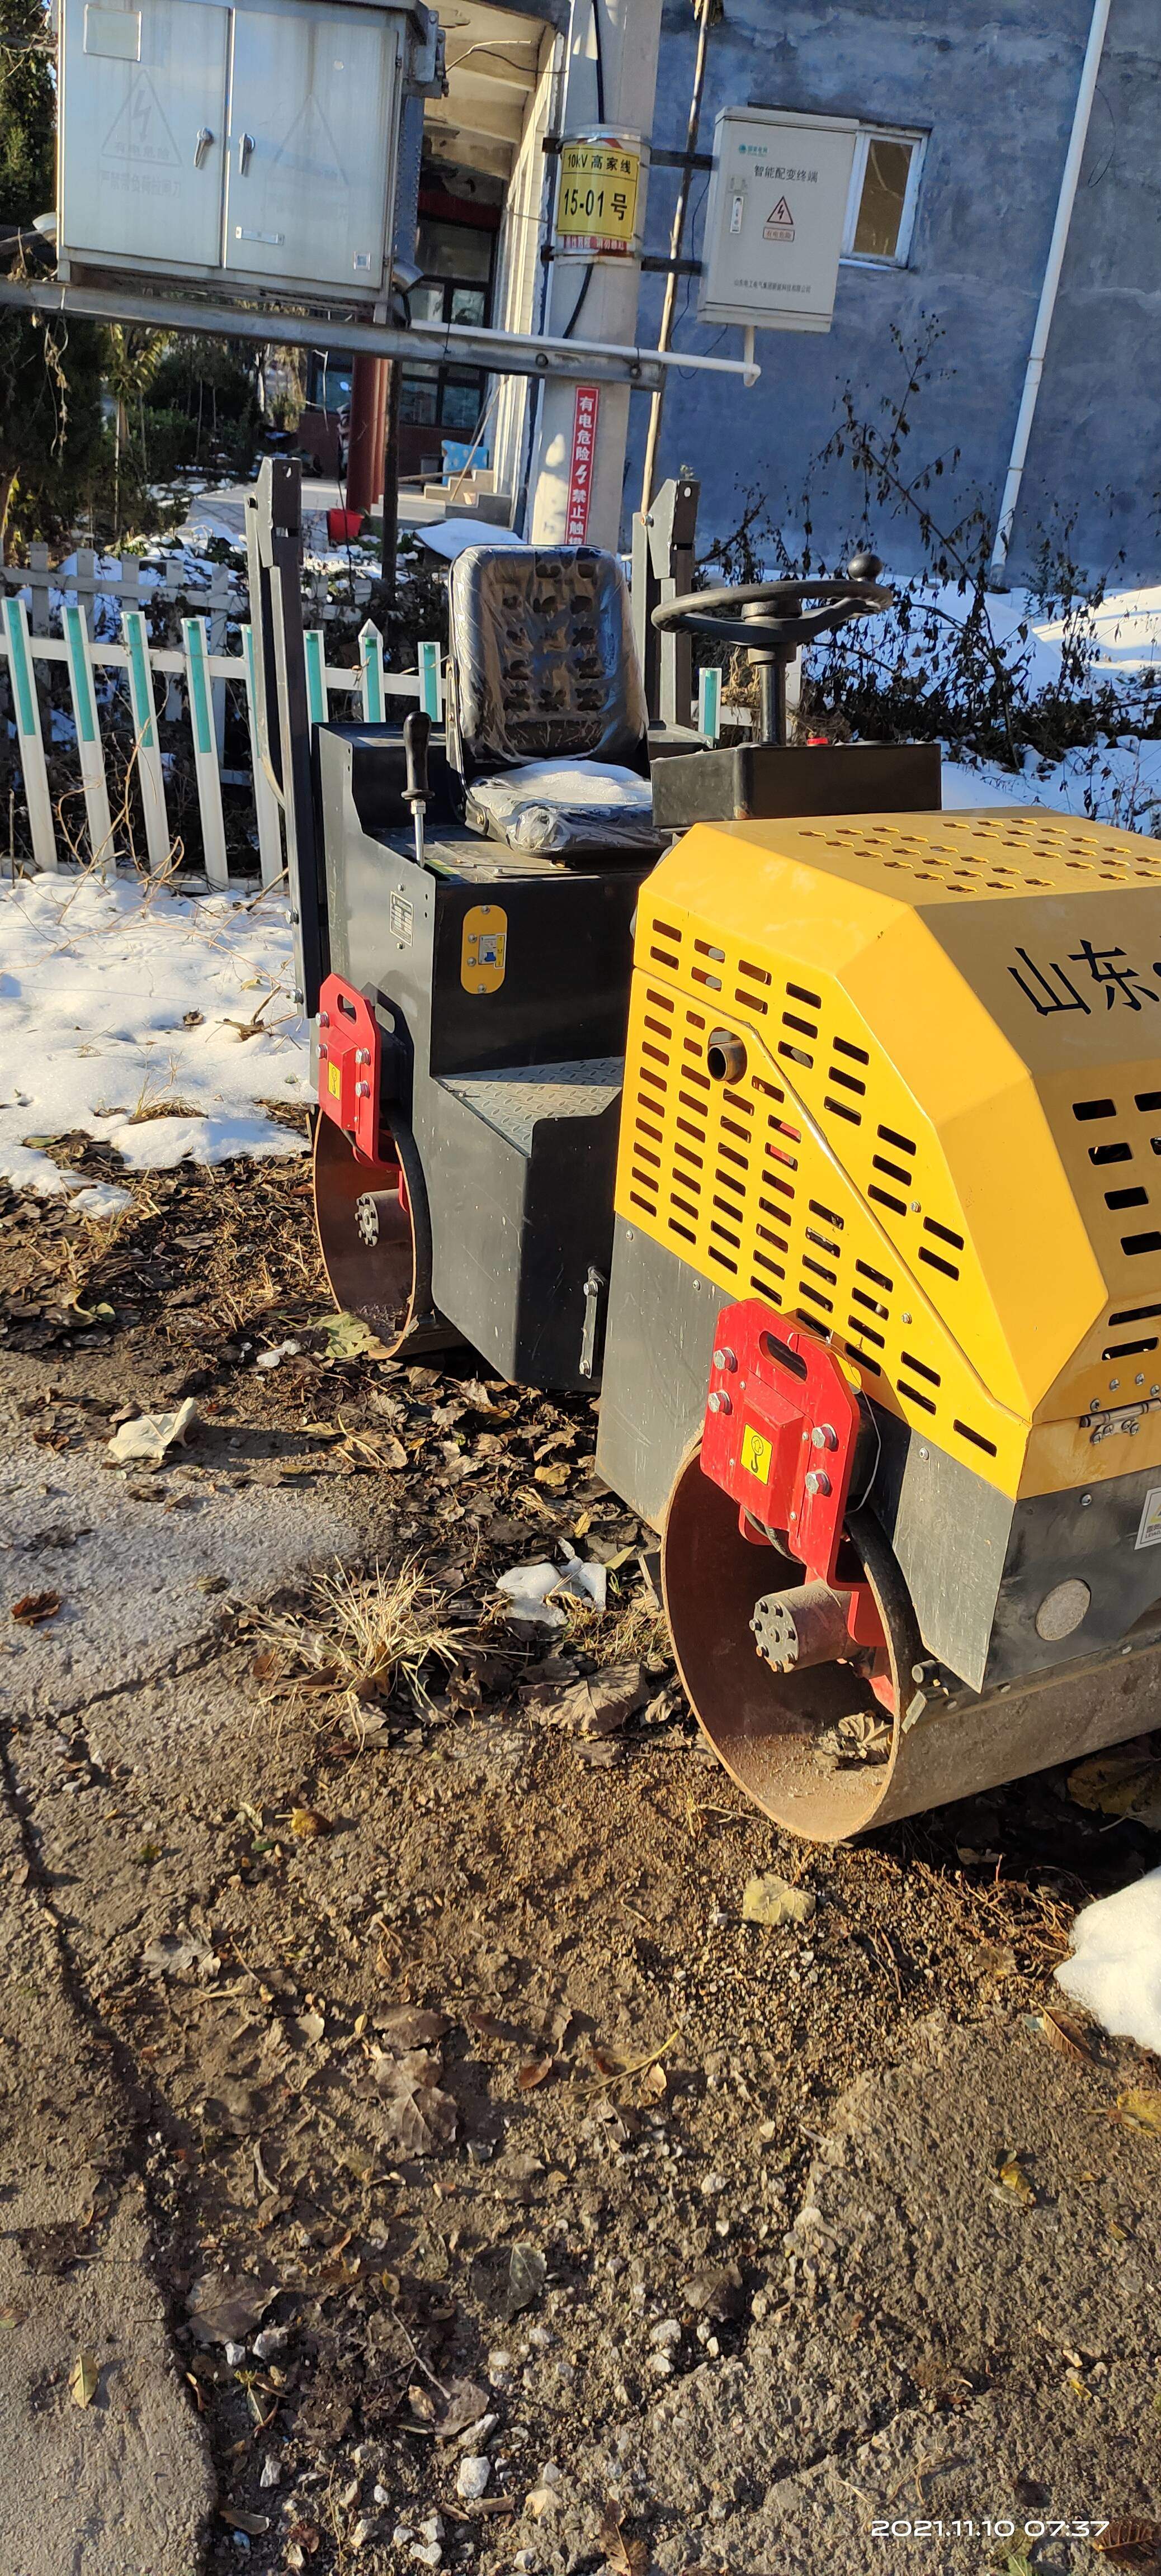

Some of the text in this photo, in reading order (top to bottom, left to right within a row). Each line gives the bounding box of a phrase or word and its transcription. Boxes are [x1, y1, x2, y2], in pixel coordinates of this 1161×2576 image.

[754, 165, 818, 183] 智能配变终端
[766, 230, 791, 239] 有电危险
[575, 396, 594, 461] 有电危险
[1007, 939, 1161, 1016] 山东
